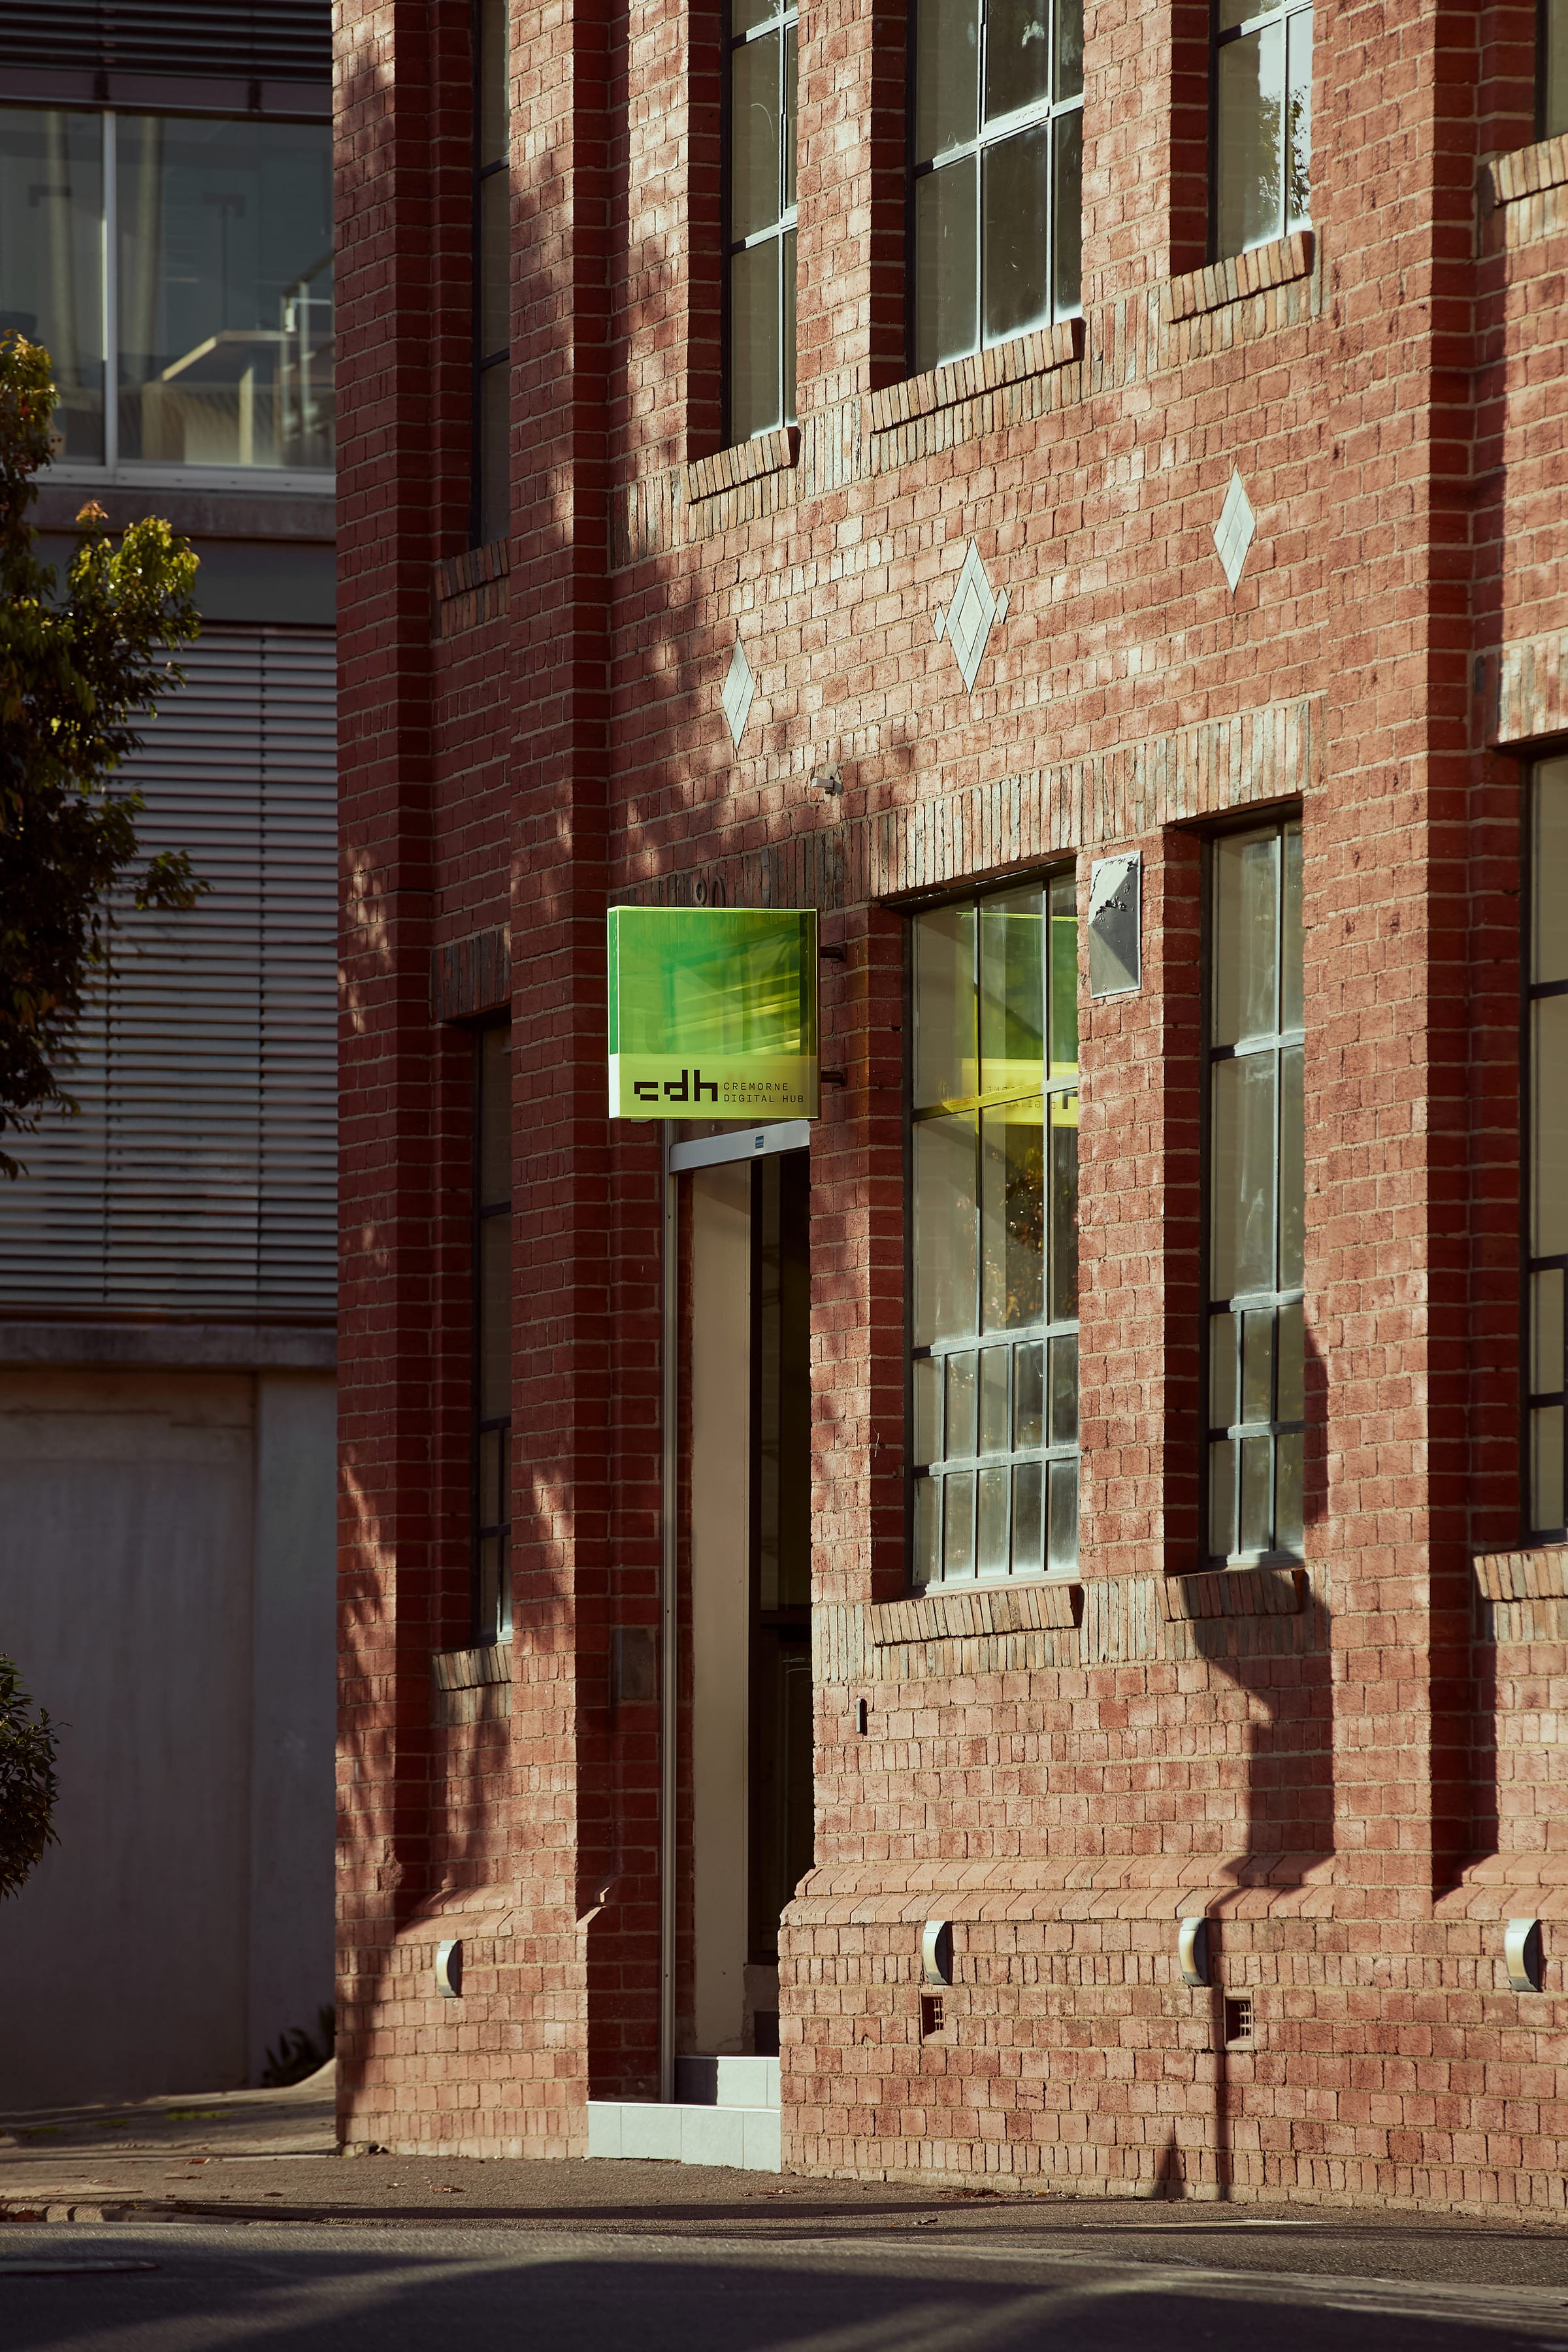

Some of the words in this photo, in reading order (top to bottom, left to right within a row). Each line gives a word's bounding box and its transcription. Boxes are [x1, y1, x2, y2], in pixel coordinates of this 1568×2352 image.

[634, 1070, 718, 1102] cdh
[723, 1082, 789, 1091] CREMORNE
[724, 1094, 774, 1103] DIGITAL
